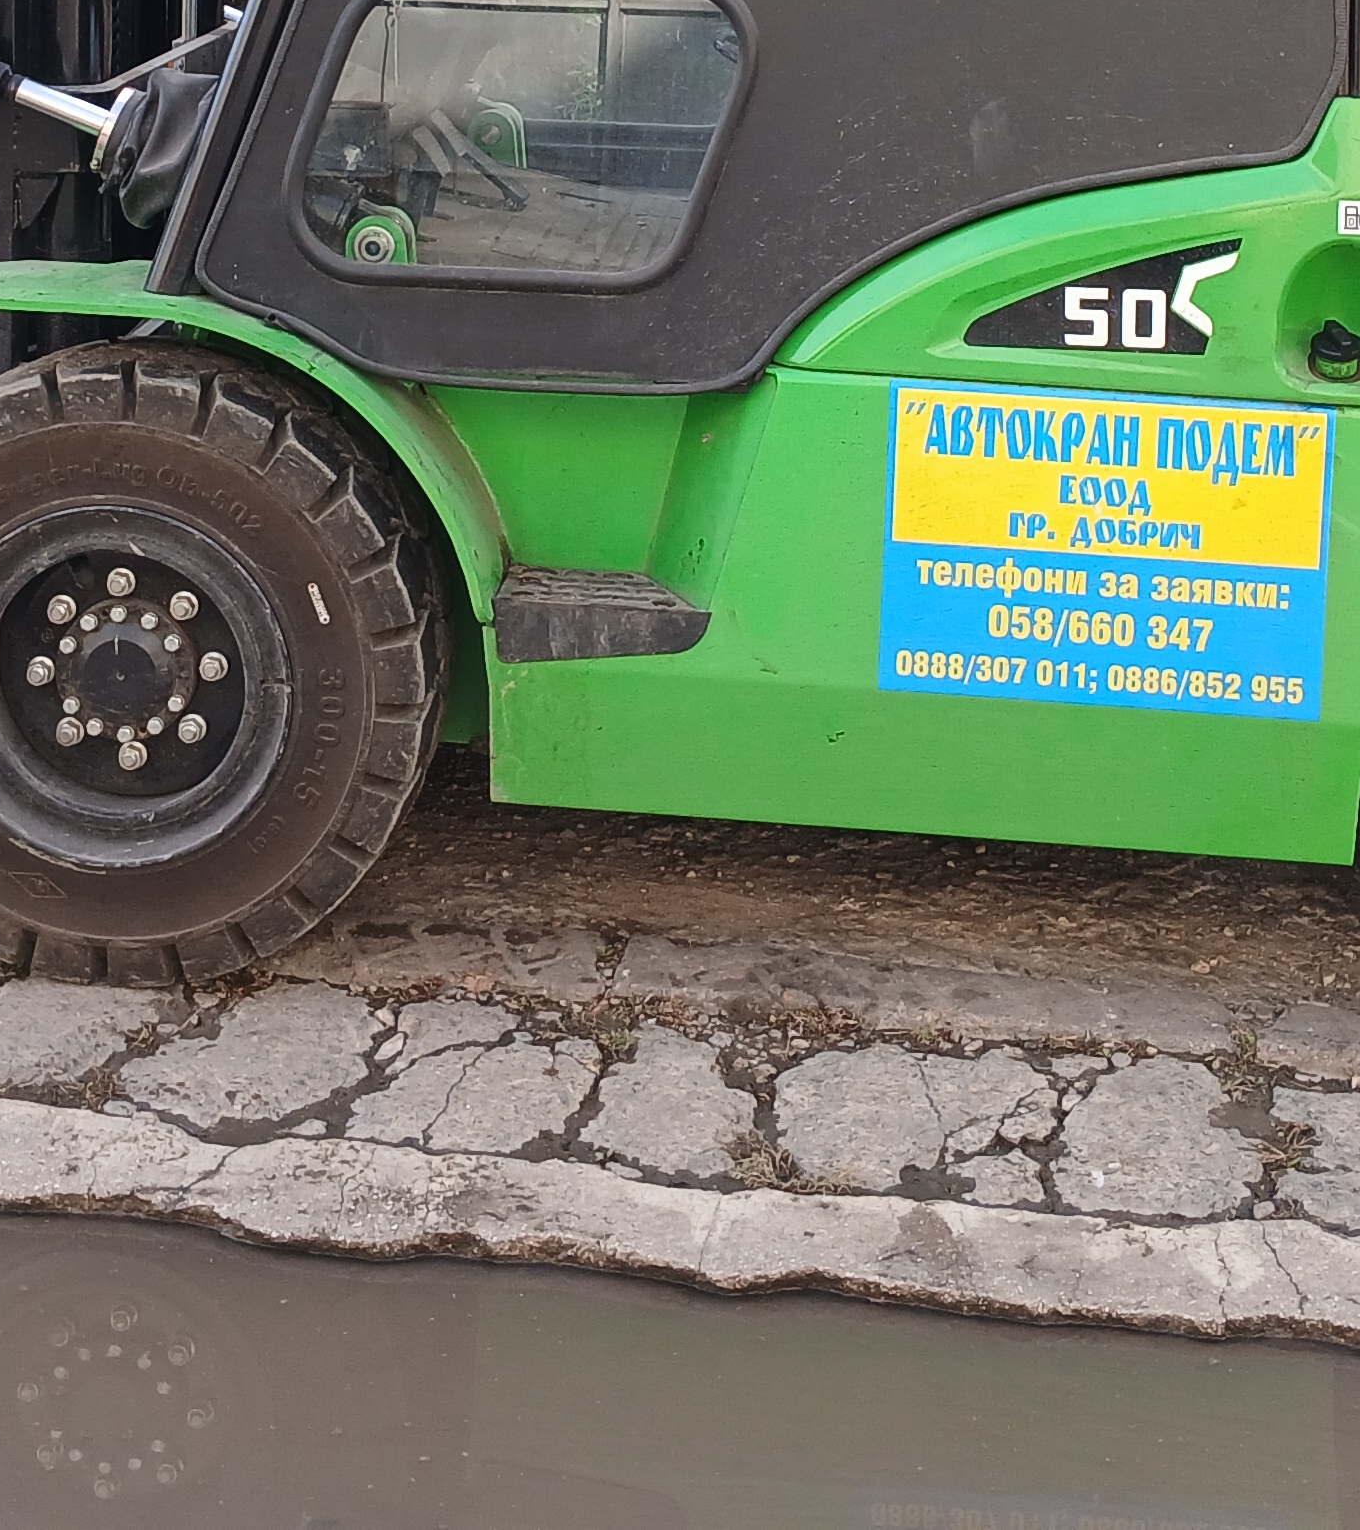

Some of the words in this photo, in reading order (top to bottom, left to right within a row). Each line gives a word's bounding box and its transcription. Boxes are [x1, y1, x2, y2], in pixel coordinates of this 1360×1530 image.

[1064, 286, 1167, 349] 50
[1059, 474, 1151, 517] ЕООД
[1008, 512, 1055, 540] ГР.
[1069, 516, 1202, 551] ДОБРИЧ
[916, 557, 1087, 598] телефони
[1099, 574, 1139, 600] за
[1150, 574, 1290, 610] заявки:
[987, 603, 1135, 649] 058/660
[1146, 615, 1214, 653] 347
[895, 649, 1029, 686] 0888/307
[1036, 660, 1098, 694] 011;
[1107, 664, 1241, 702] 0886/852
[1251, 677, 1305, 705] 955
[292, 668, 346, 812] 300-15
